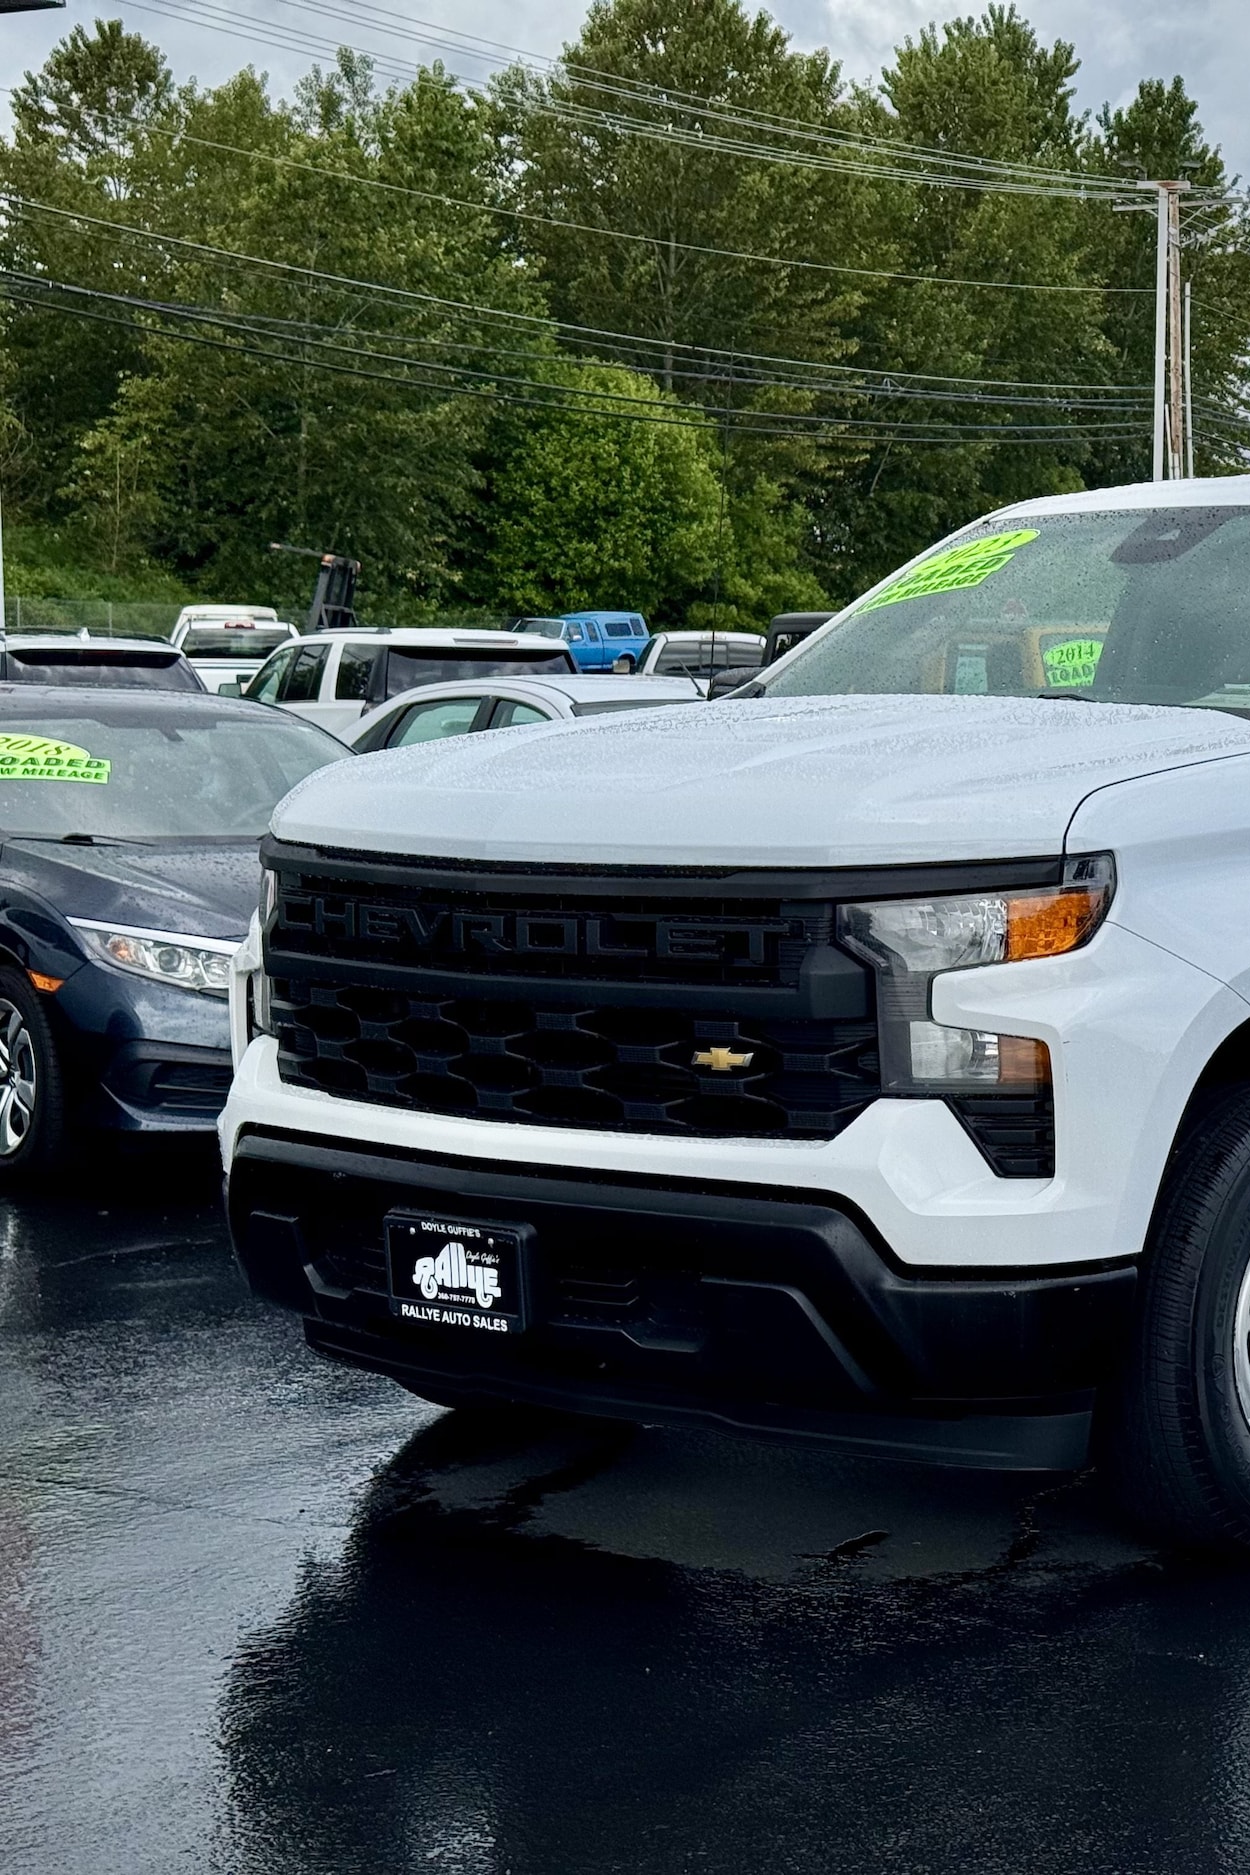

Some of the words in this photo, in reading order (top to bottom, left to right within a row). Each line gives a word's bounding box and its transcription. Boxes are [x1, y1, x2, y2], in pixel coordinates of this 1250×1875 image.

[922, 533, 1022, 570] 2023
[881, 556, 1006, 595] LOADED
[896, 571, 988, 600] MILEAGE
[1056, 642, 1095, 665] 2014
[1051, 664, 1094, 684] LOAD
[0, 756, 105, 769] OADED
[22, 768, 104, 780] MILEAGE
[279, 895, 791, 963] CHEVROLET
[421, 1221, 447, 1234] DOYLE
[447, 1225, 481, 1238] GUFFIE'S
[401, 1304, 440, 1321] RALLYE
[442, 1311, 471, 1326] AUTO
[473, 1315, 508, 1332] SALES
